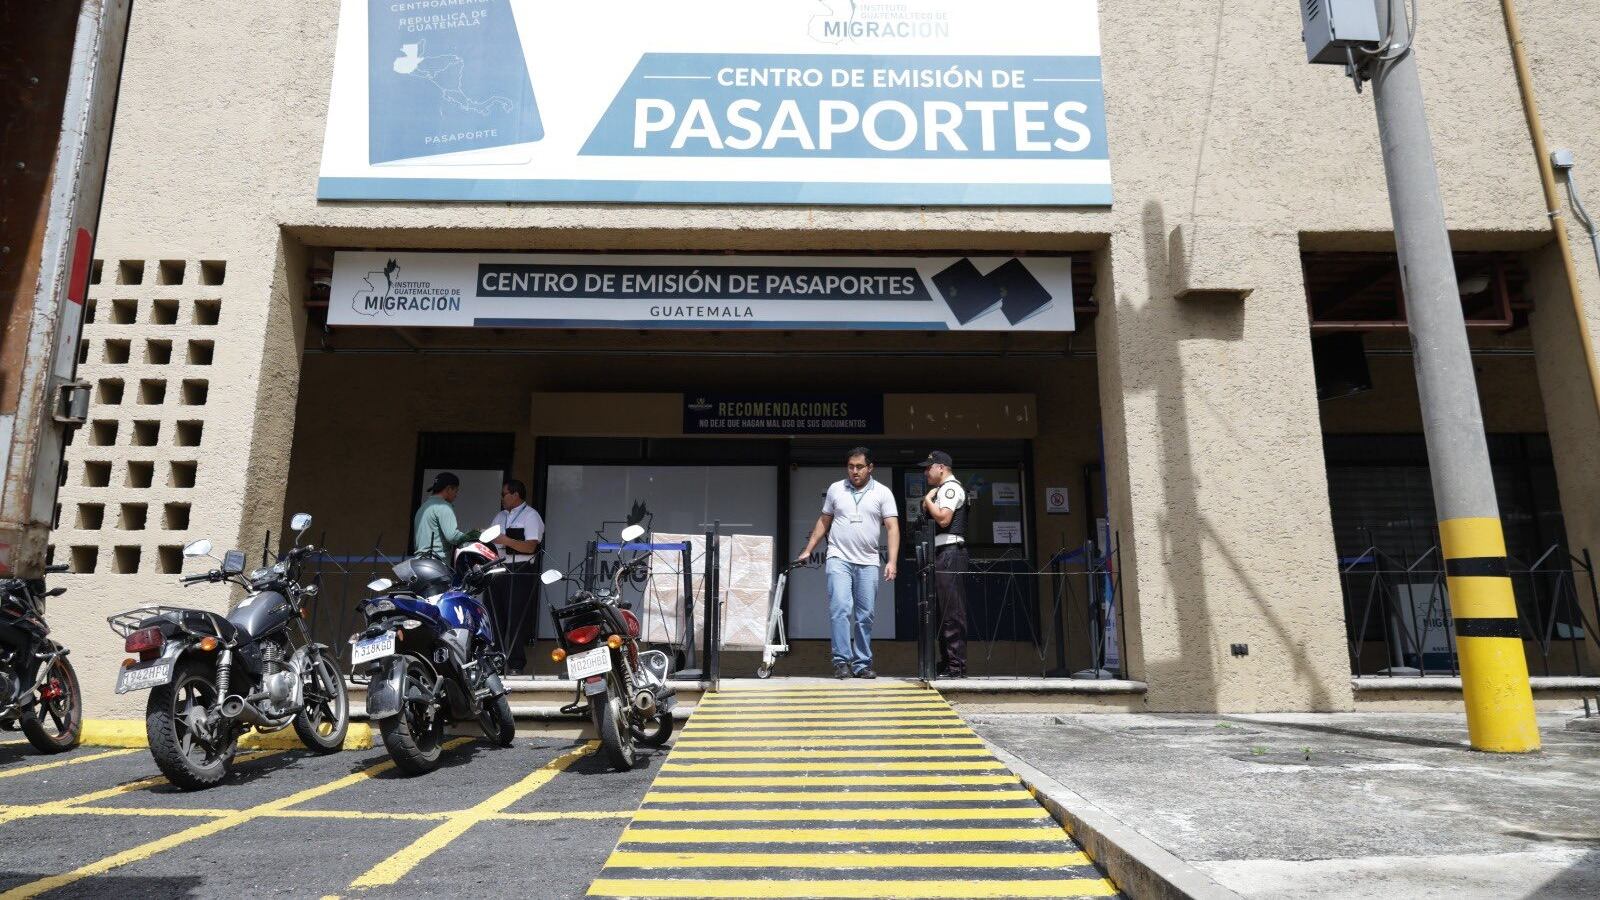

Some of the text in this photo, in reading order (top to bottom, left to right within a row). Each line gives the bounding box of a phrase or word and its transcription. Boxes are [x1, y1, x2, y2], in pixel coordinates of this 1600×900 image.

[472, 9, 488, 18] DE
[407, 18, 481, 33] GUATEMALA
[717, 65, 1026, 89] CENTRO DE EMISIÓN DE
[633, 98, 1092, 153] PASAPORTES
[425, 128, 498, 145] PASAPORTE
[394, 281, 431, 289] INSTITUTO
[482, 269, 915, 295] CENTRO DE EMISIÓN DE PASAPORTES
[394, 288, 461, 296] GUATEMALTECO DE
[650, 305, 753, 318] GUATEMALA
[718, 402, 848, 417] RECOMENDACIONES
[699, 419, 709, 428] NO
[710, 419, 725, 428] DEJE
[727, 419, 740, 428] QUE
[742, 419, 765, 428] HAGAN
[766, 419, 780, 428] MAL
[797, 419, 806, 428] DE
[821, 419, 867, 428] DOCUMENTOS
